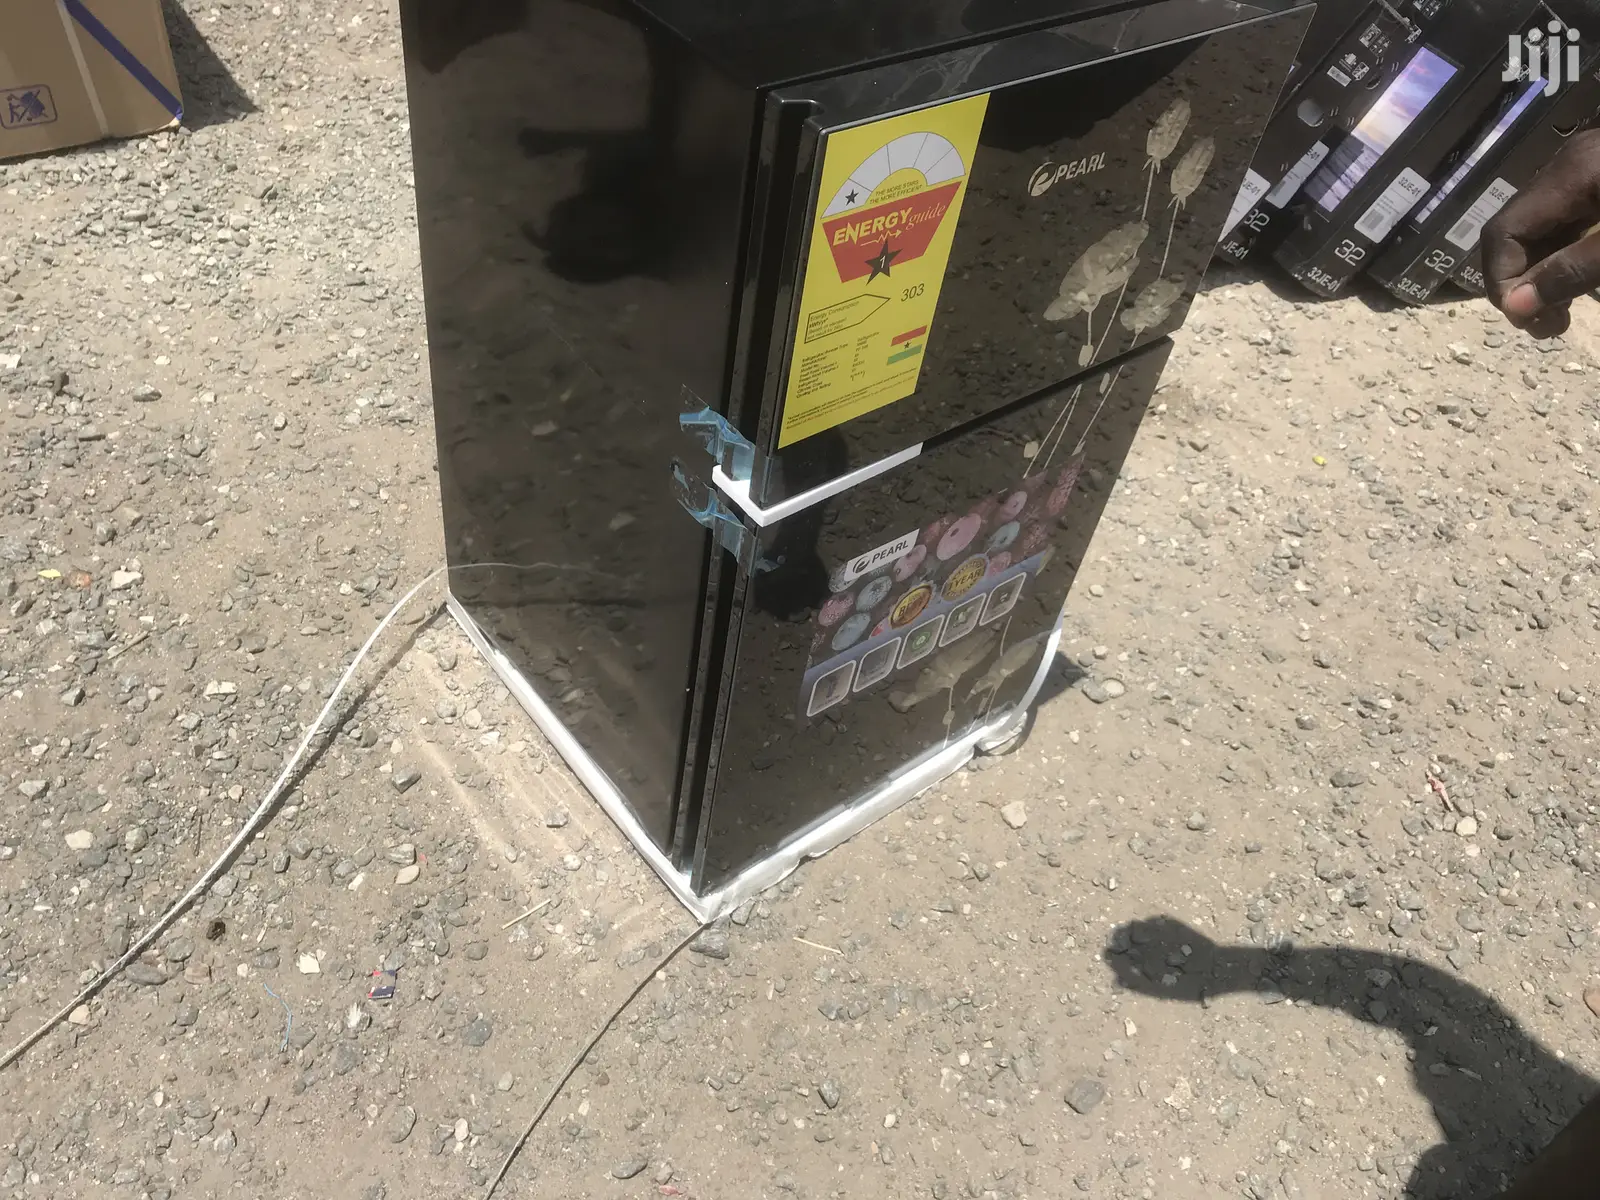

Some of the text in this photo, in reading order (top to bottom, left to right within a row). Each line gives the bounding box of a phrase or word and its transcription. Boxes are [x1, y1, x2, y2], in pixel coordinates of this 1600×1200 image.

[1054, 152, 1105, 184] PEARL
[1398, 176, 1421, 197] 32JE-01
[832, 203, 946, 246] ENERGY guide
[1243, 208, 1270, 232] 32
[879, 255, 886, 269] 1
[1334, 239, 1366, 266] 32
[1424, 249, 1455, 274] 32
[1307, 266, 1340, 292] 32JE-01
[1398, 277, 1431, 301] 32JE-01
[900, 283, 925, 302] 303
[872, 540, 909, 563] PEARL
